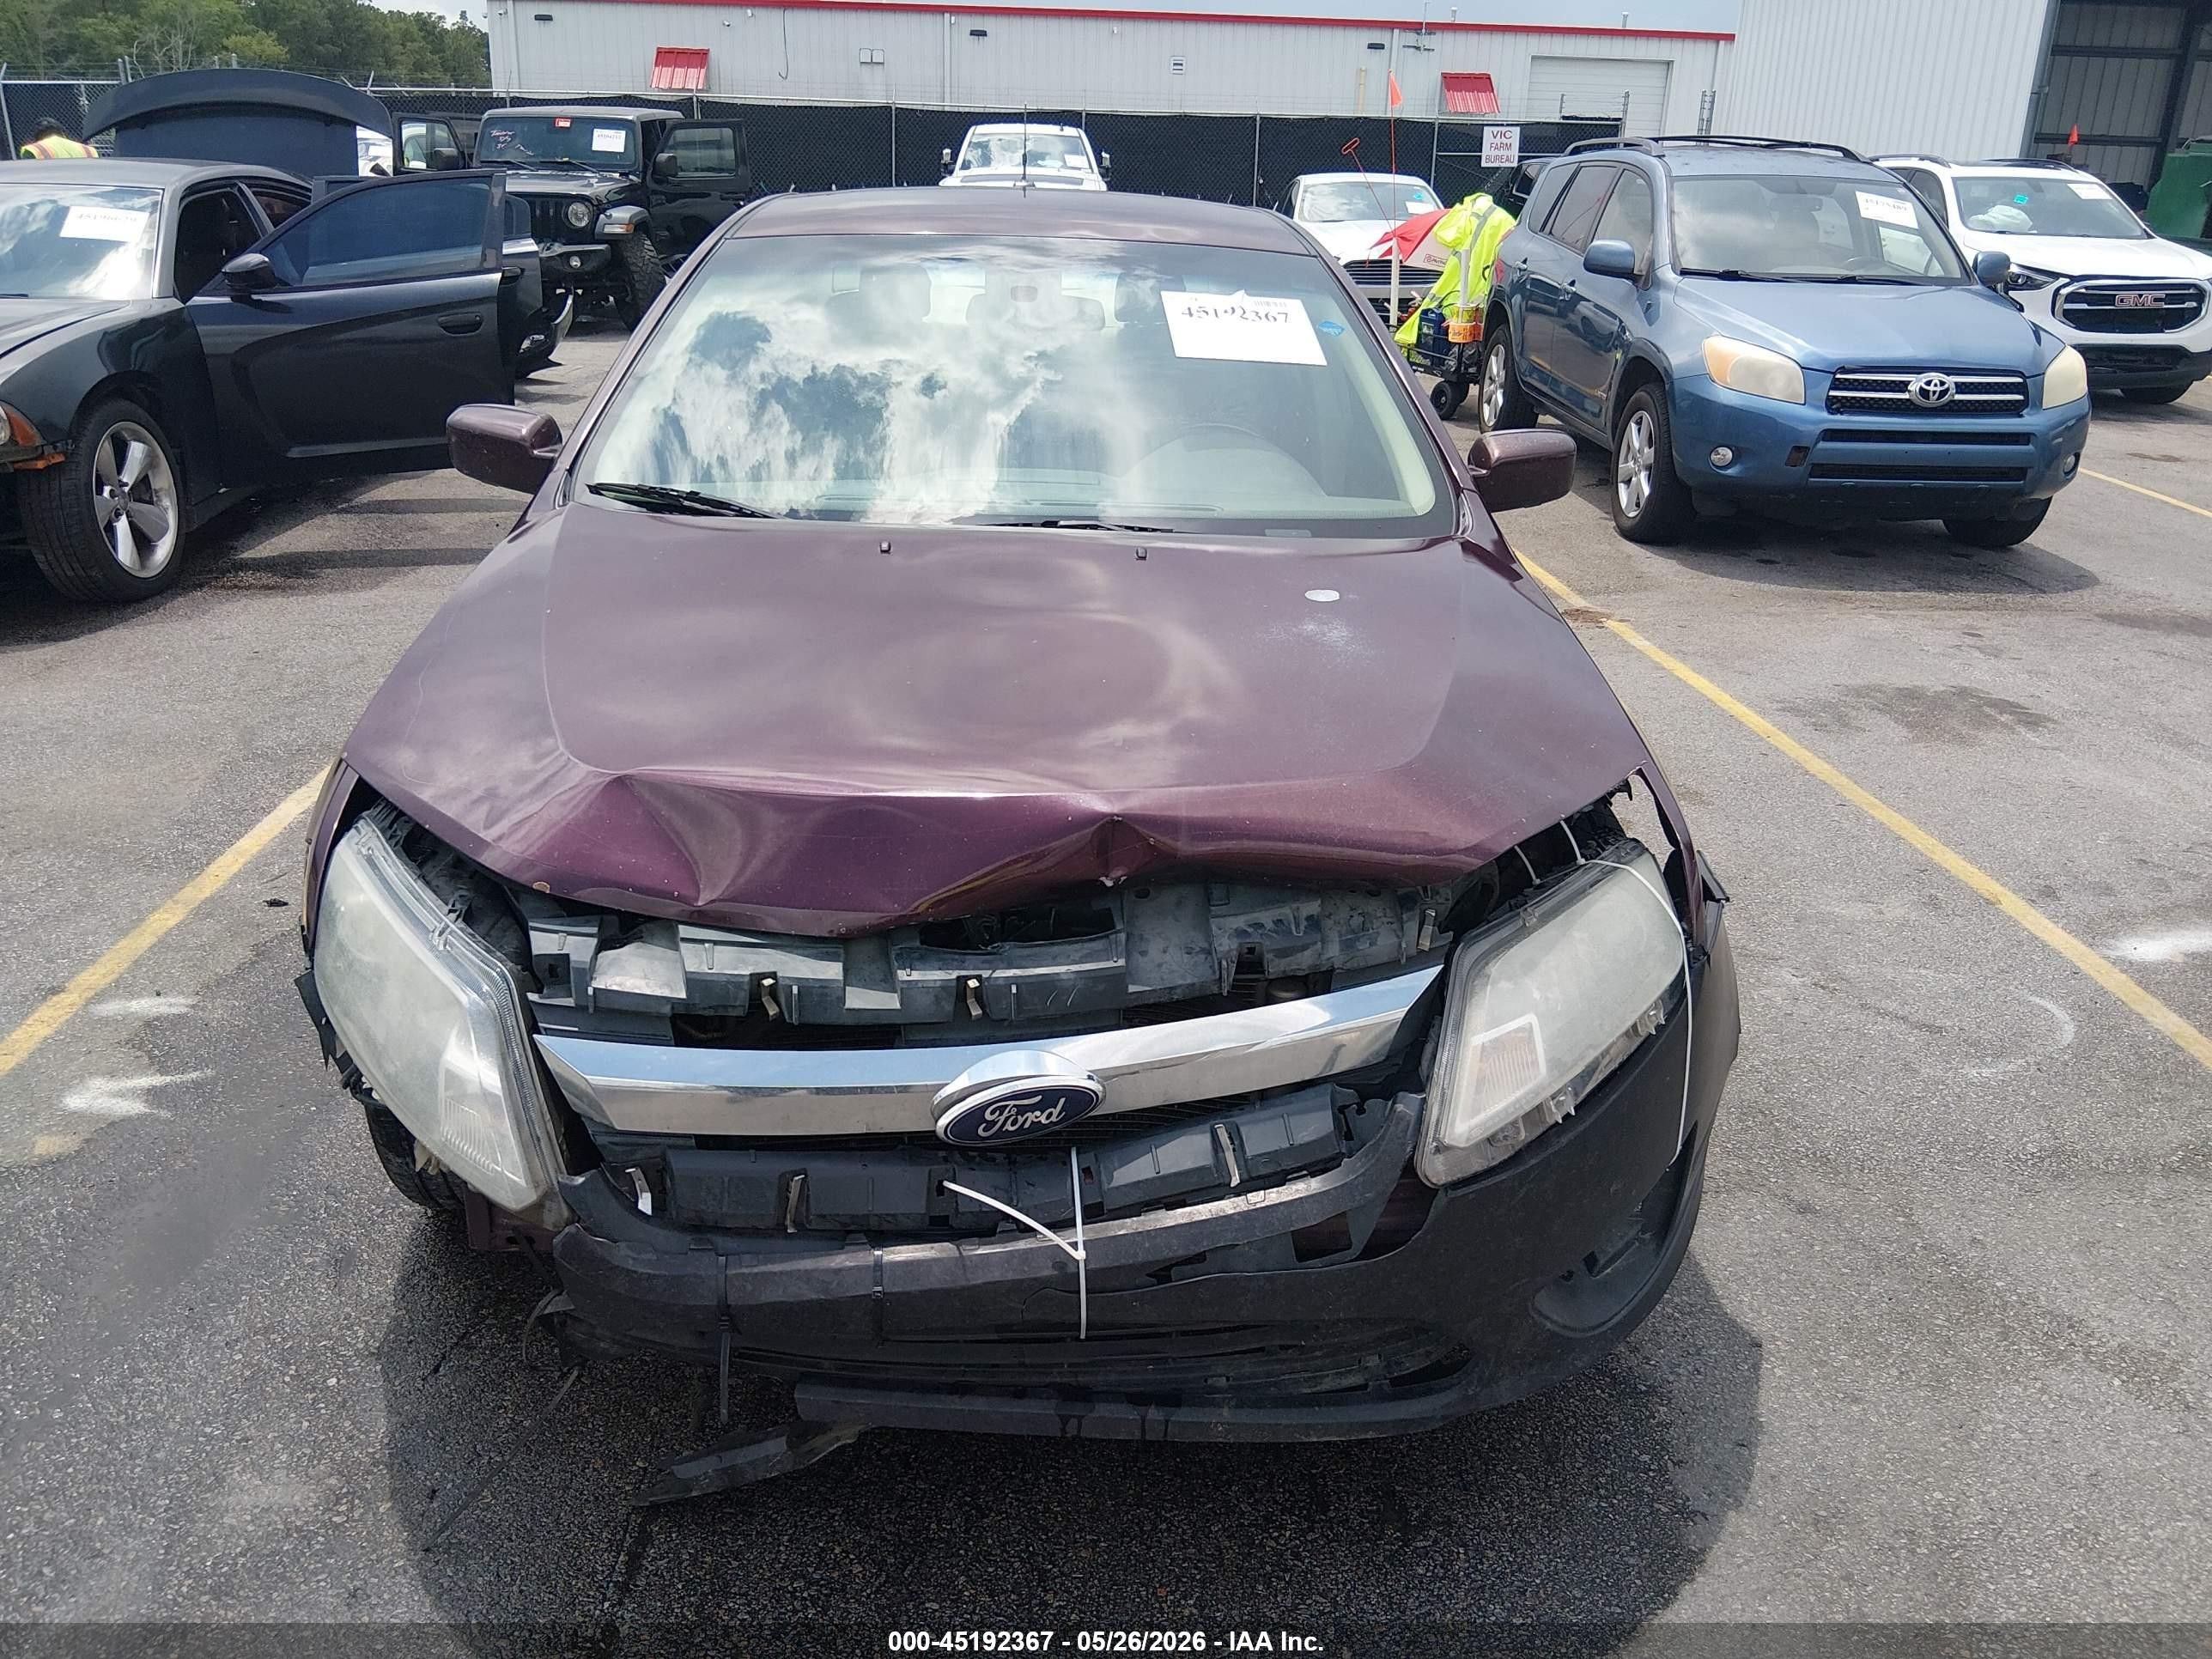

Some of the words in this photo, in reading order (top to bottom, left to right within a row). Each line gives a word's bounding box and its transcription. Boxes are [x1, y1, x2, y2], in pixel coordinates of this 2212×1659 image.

[1491, 130, 1513, 139] VIC
[1489, 143, 1512, 152] FARM
[1485, 154, 1515, 164] BUREAU
[2115, 294, 2166, 307] GMC
[977, 1095, 1066, 1138] Ford
